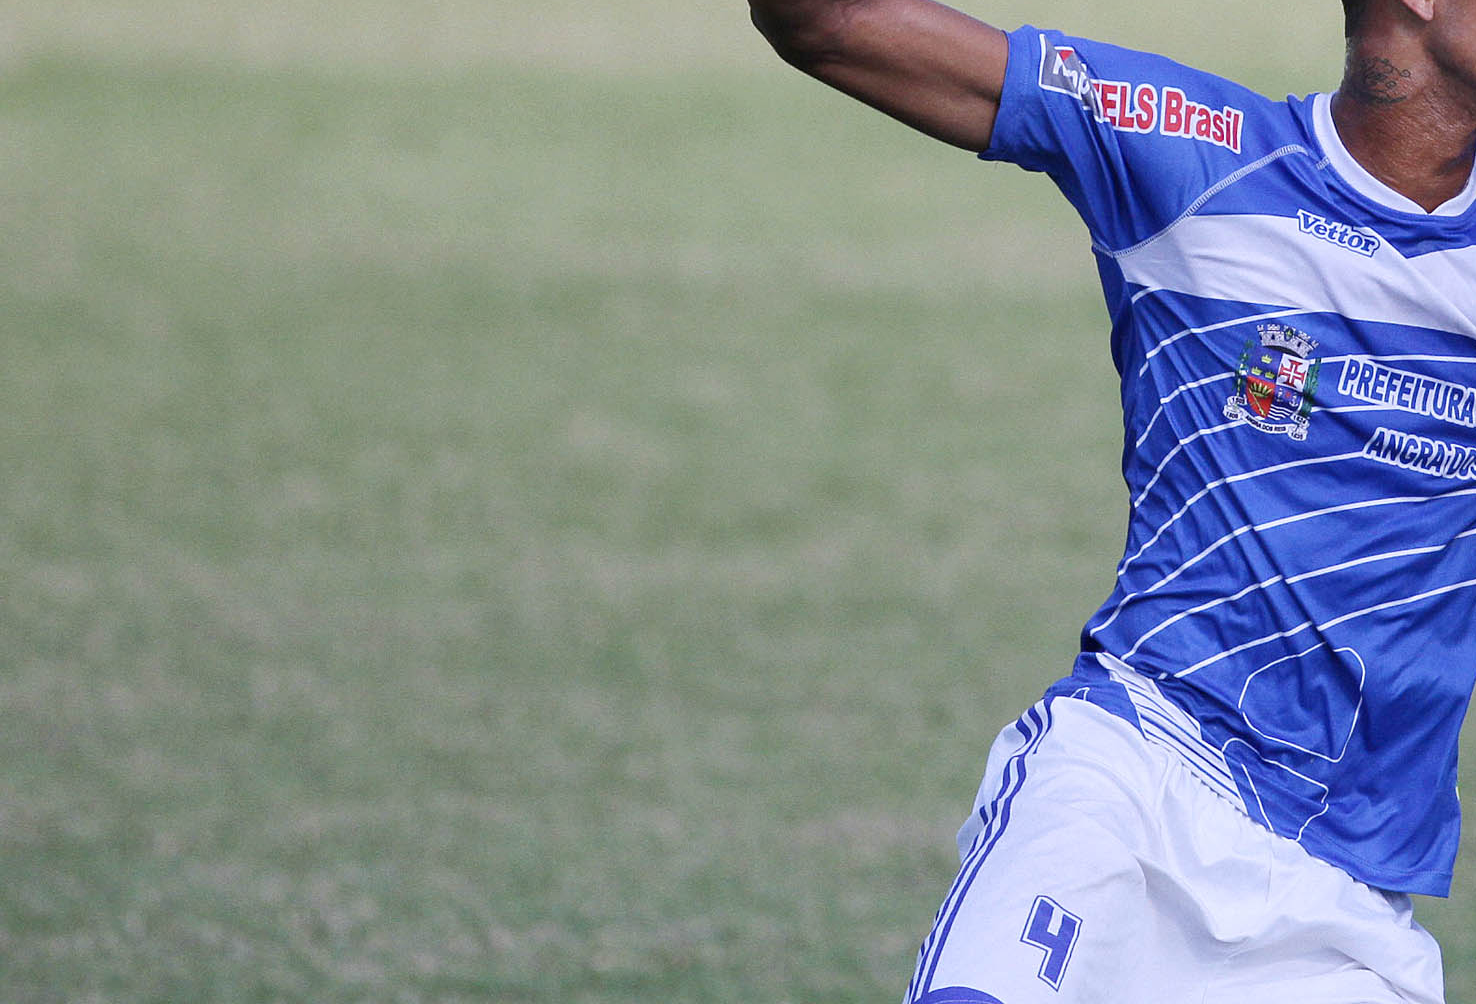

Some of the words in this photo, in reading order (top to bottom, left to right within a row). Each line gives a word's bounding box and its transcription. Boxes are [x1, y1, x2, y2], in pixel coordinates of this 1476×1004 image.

[1163, 89, 1241, 151] Brasil
[1299, 211, 1377, 254] Vettor
[1365, 429, 1444, 474] ANGRA
[1022, 897, 1081, 990] 4
